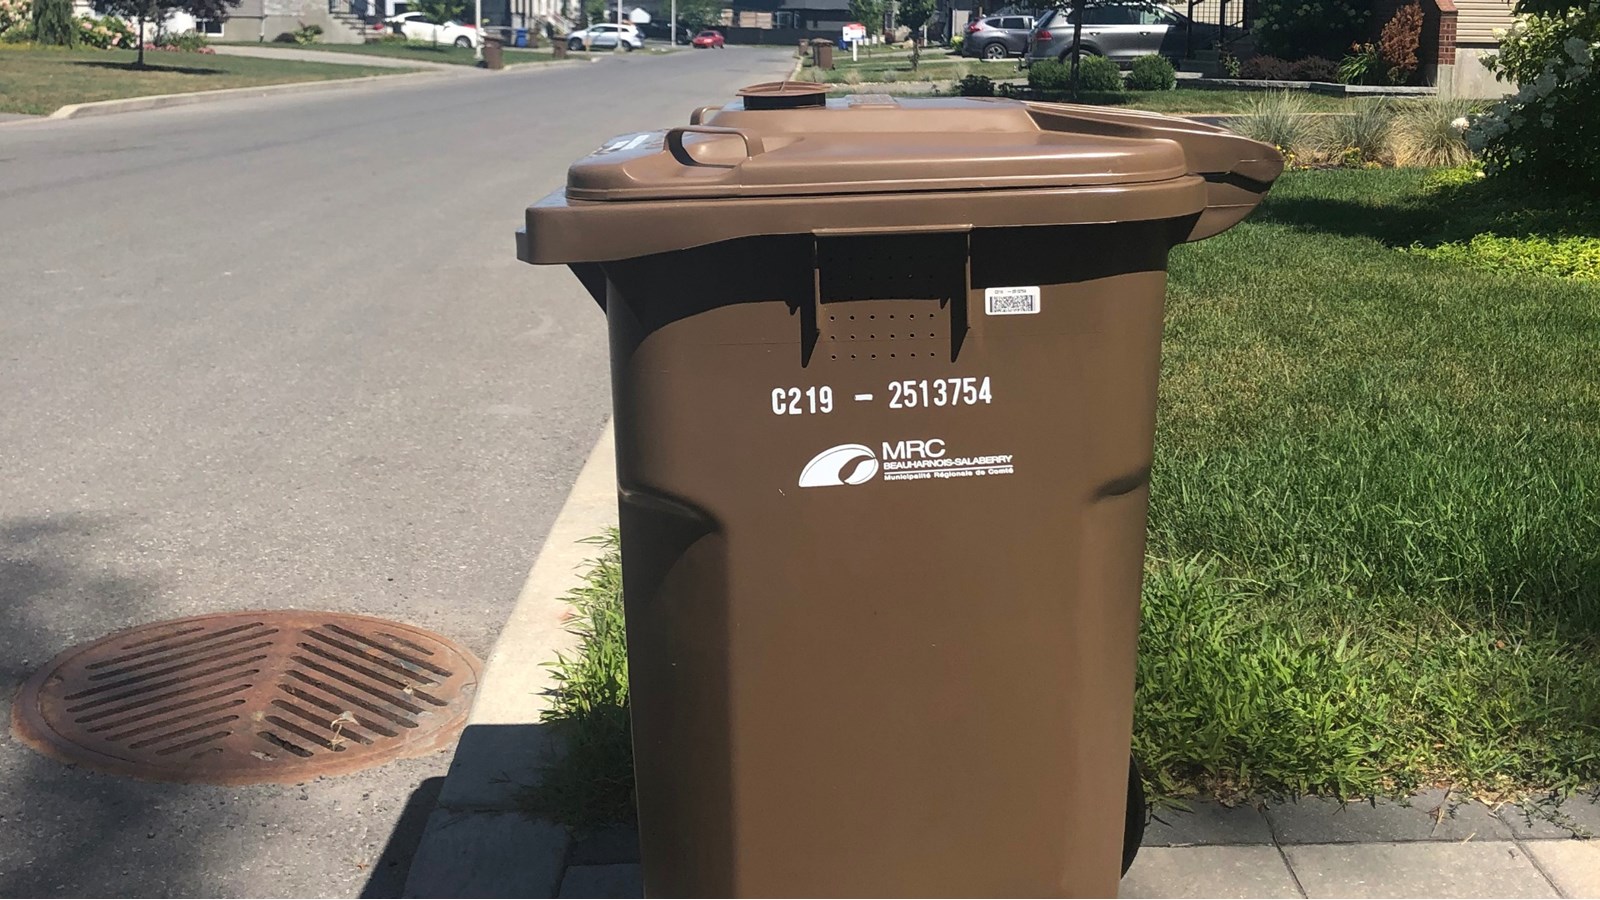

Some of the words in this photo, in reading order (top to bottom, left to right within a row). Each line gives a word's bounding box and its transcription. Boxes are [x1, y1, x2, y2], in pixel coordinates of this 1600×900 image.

[771, 386, 833, 415] C219
[888, 376, 992, 409] 2513754
[882, 438, 946, 460] MRC
[883, 454, 1013, 470] BEAUHARNOIS-SALABERRY
[884, 472, 931, 481] Municipalité
[933, 469, 973, 479] Régionale
[988, 467, 1014, 475] Comté
